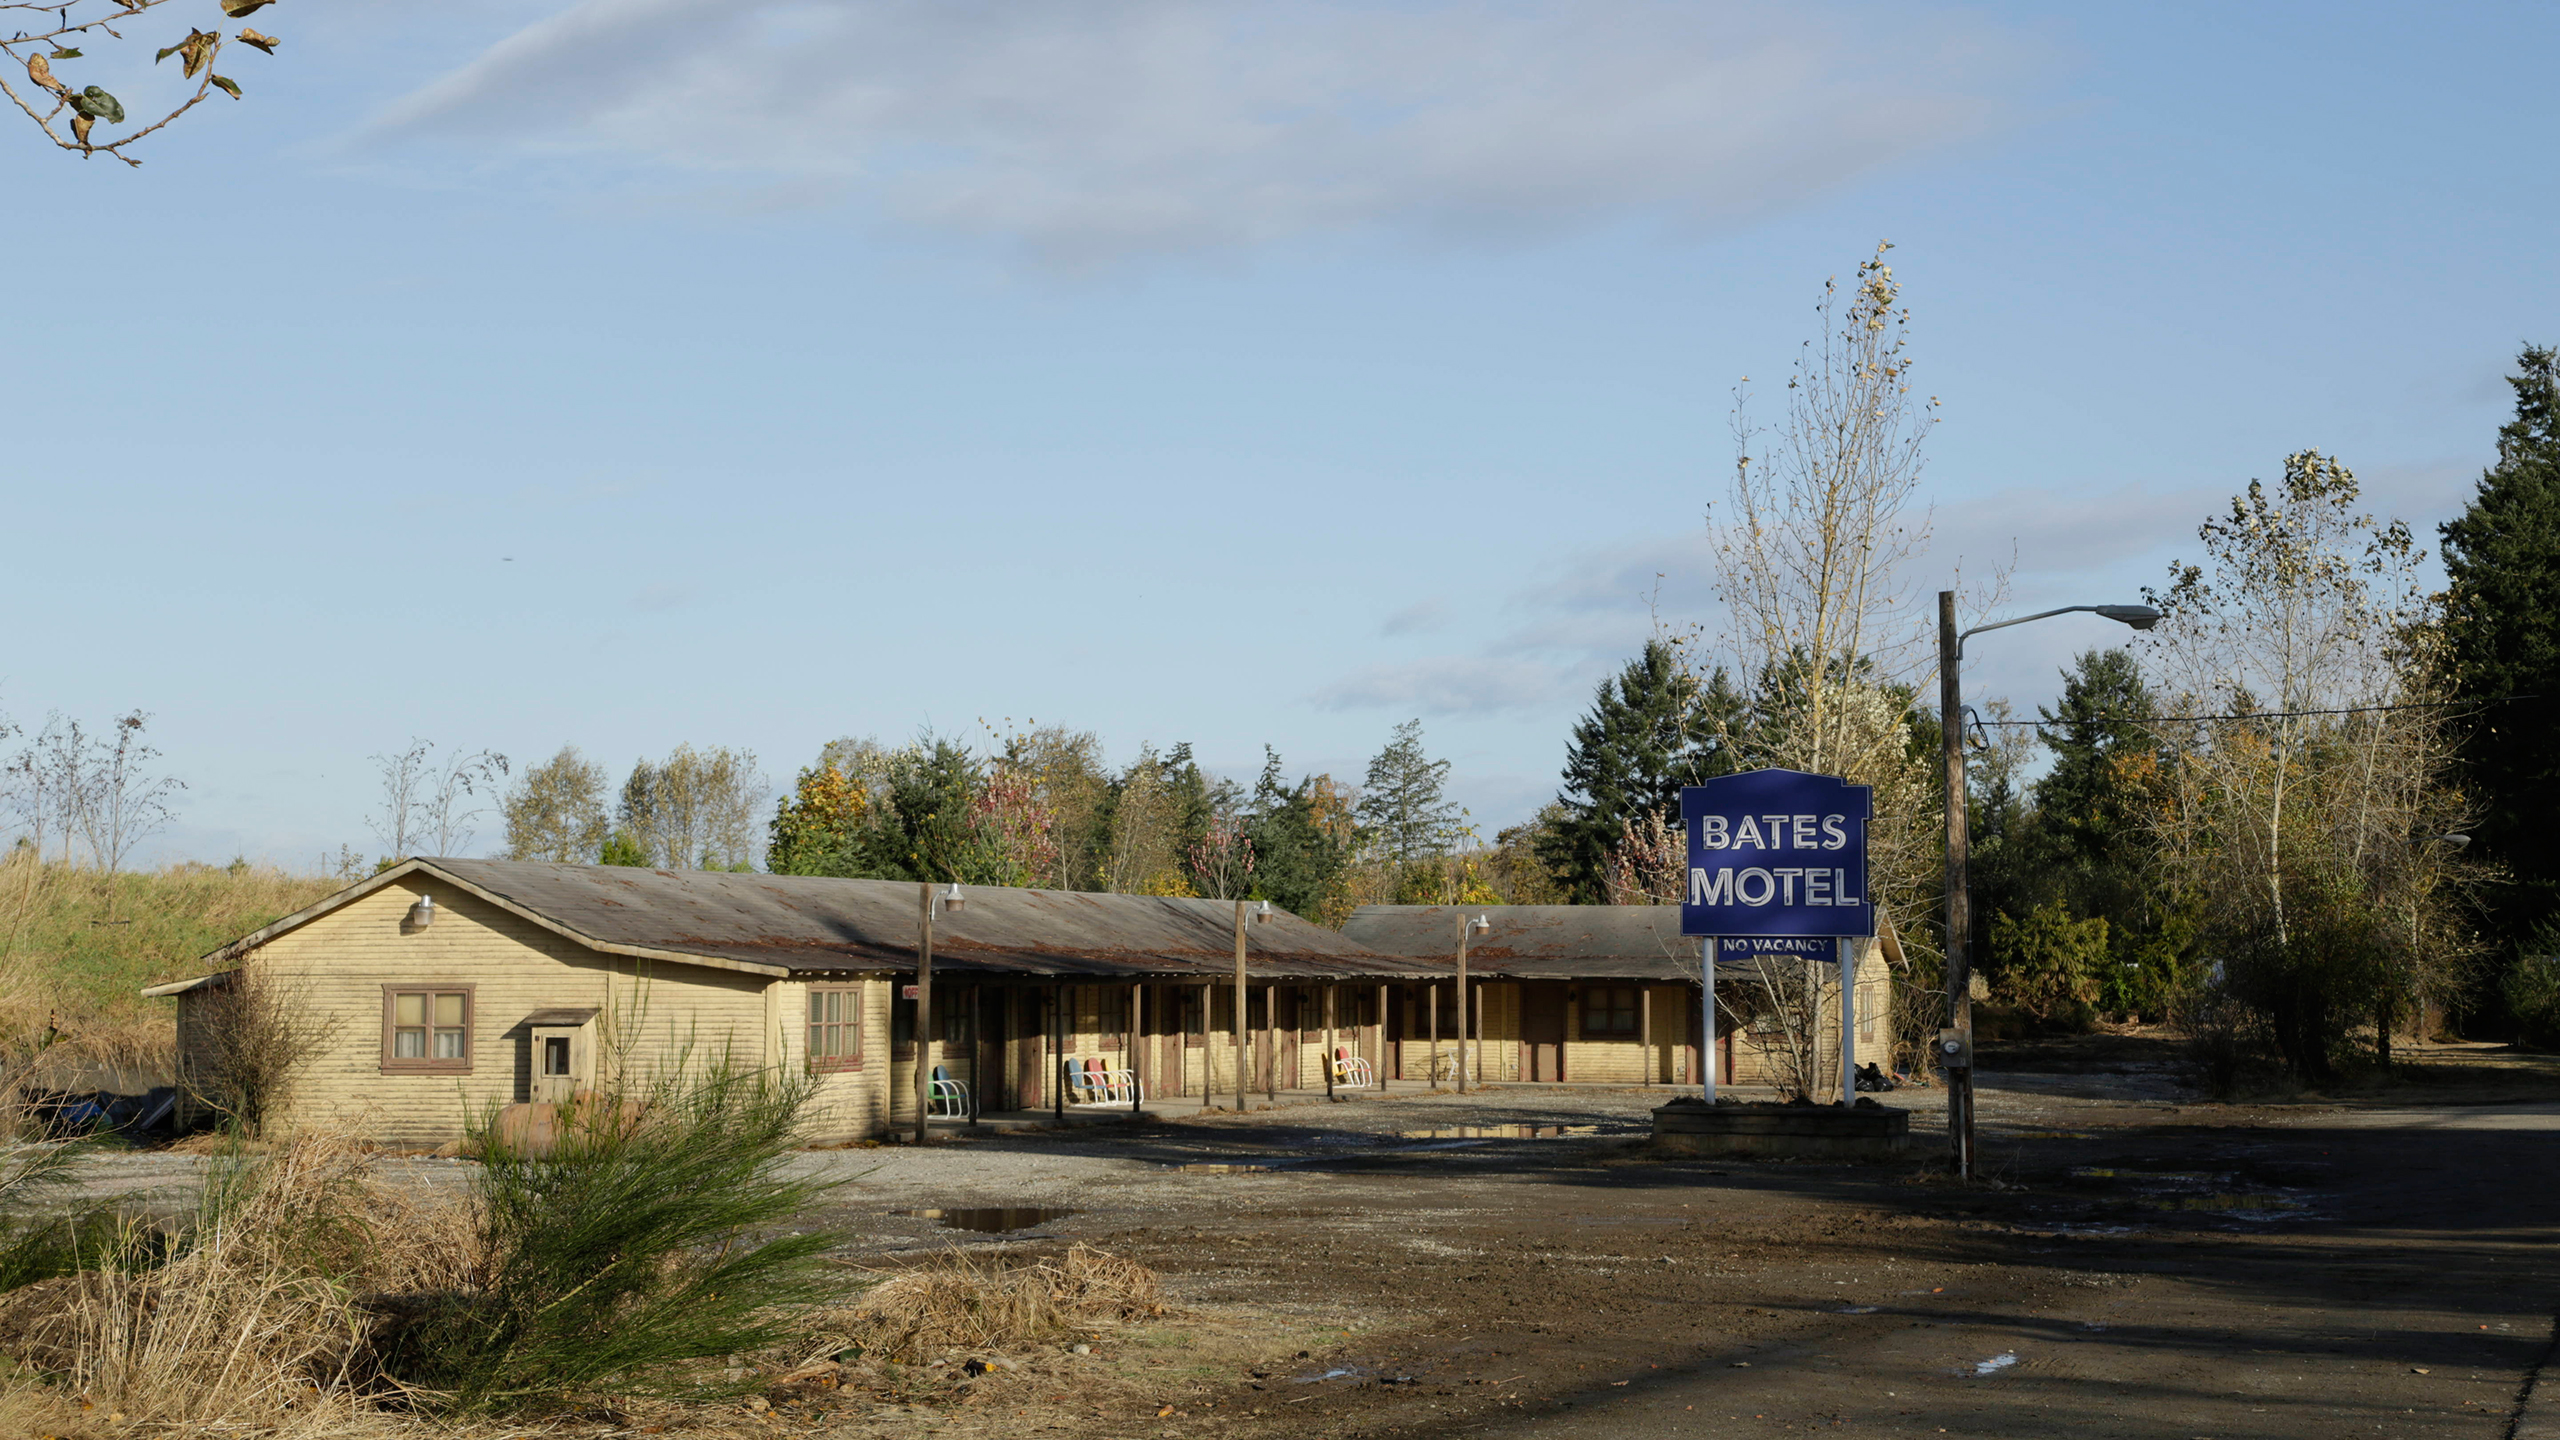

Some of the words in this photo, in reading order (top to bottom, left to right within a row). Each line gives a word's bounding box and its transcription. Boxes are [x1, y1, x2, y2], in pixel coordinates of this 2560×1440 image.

[1703, 814, 1846, 850] BATES
[1691, 867, 1860, 907] MOTEL
[1723, 939, 1748, 952] NO
[1752, 939, 1828, 952] VACANCY
